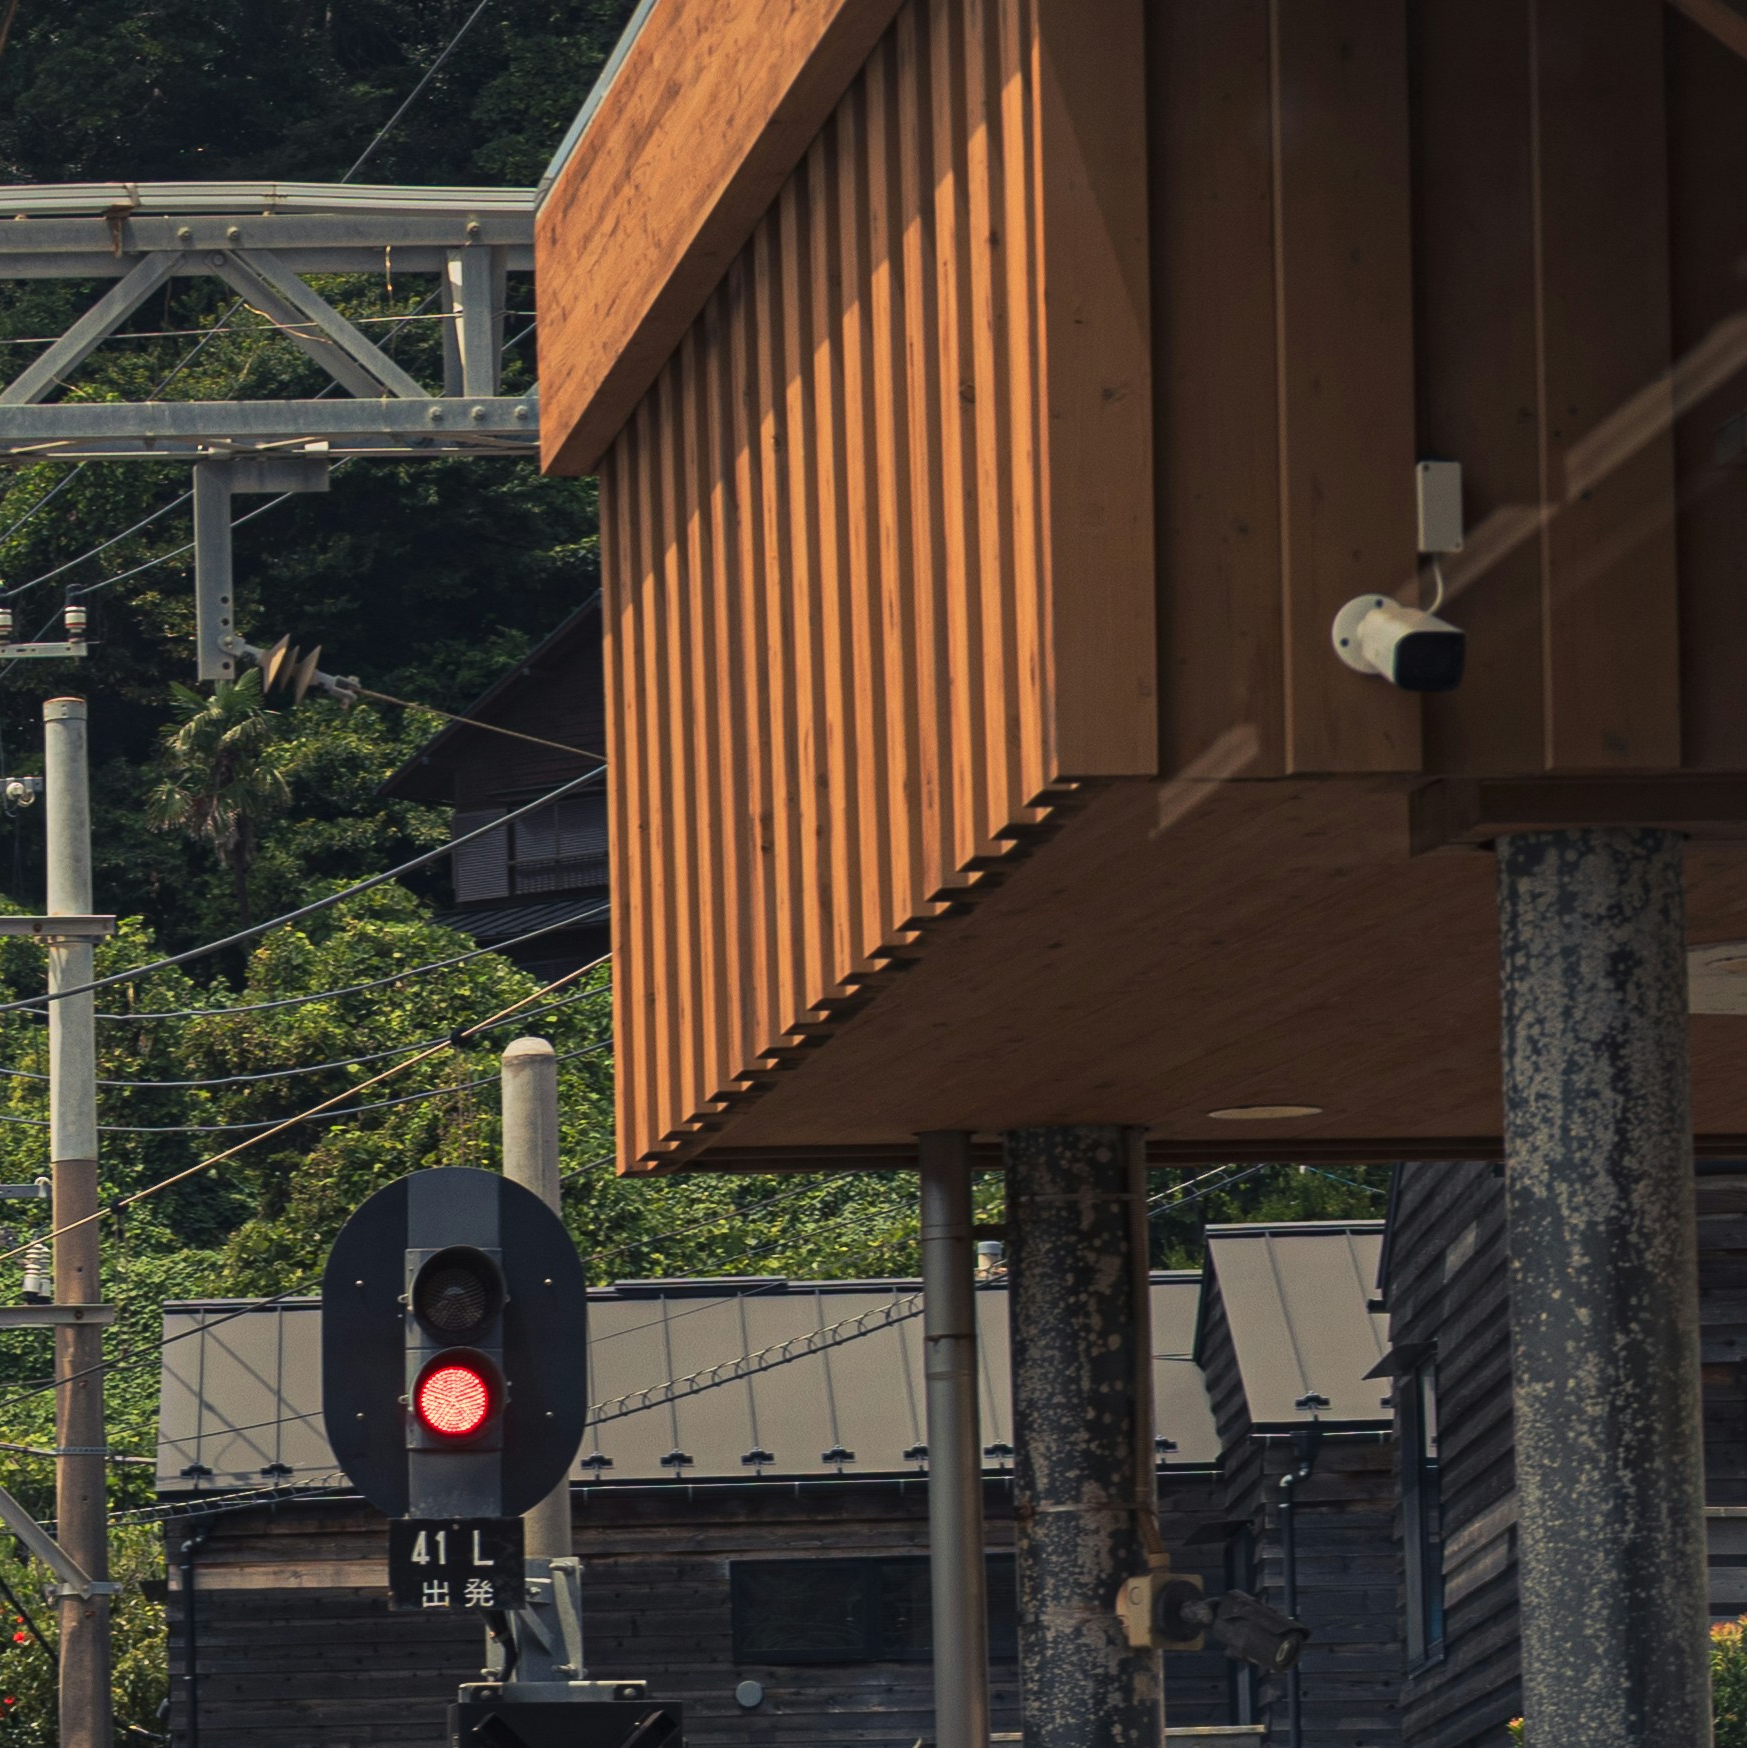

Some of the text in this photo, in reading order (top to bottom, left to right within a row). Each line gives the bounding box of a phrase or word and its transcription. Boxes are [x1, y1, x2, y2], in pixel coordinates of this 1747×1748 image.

[411, 1530, 495, 1566] 41 L
[422, 1578, 495, 1608] 出発
